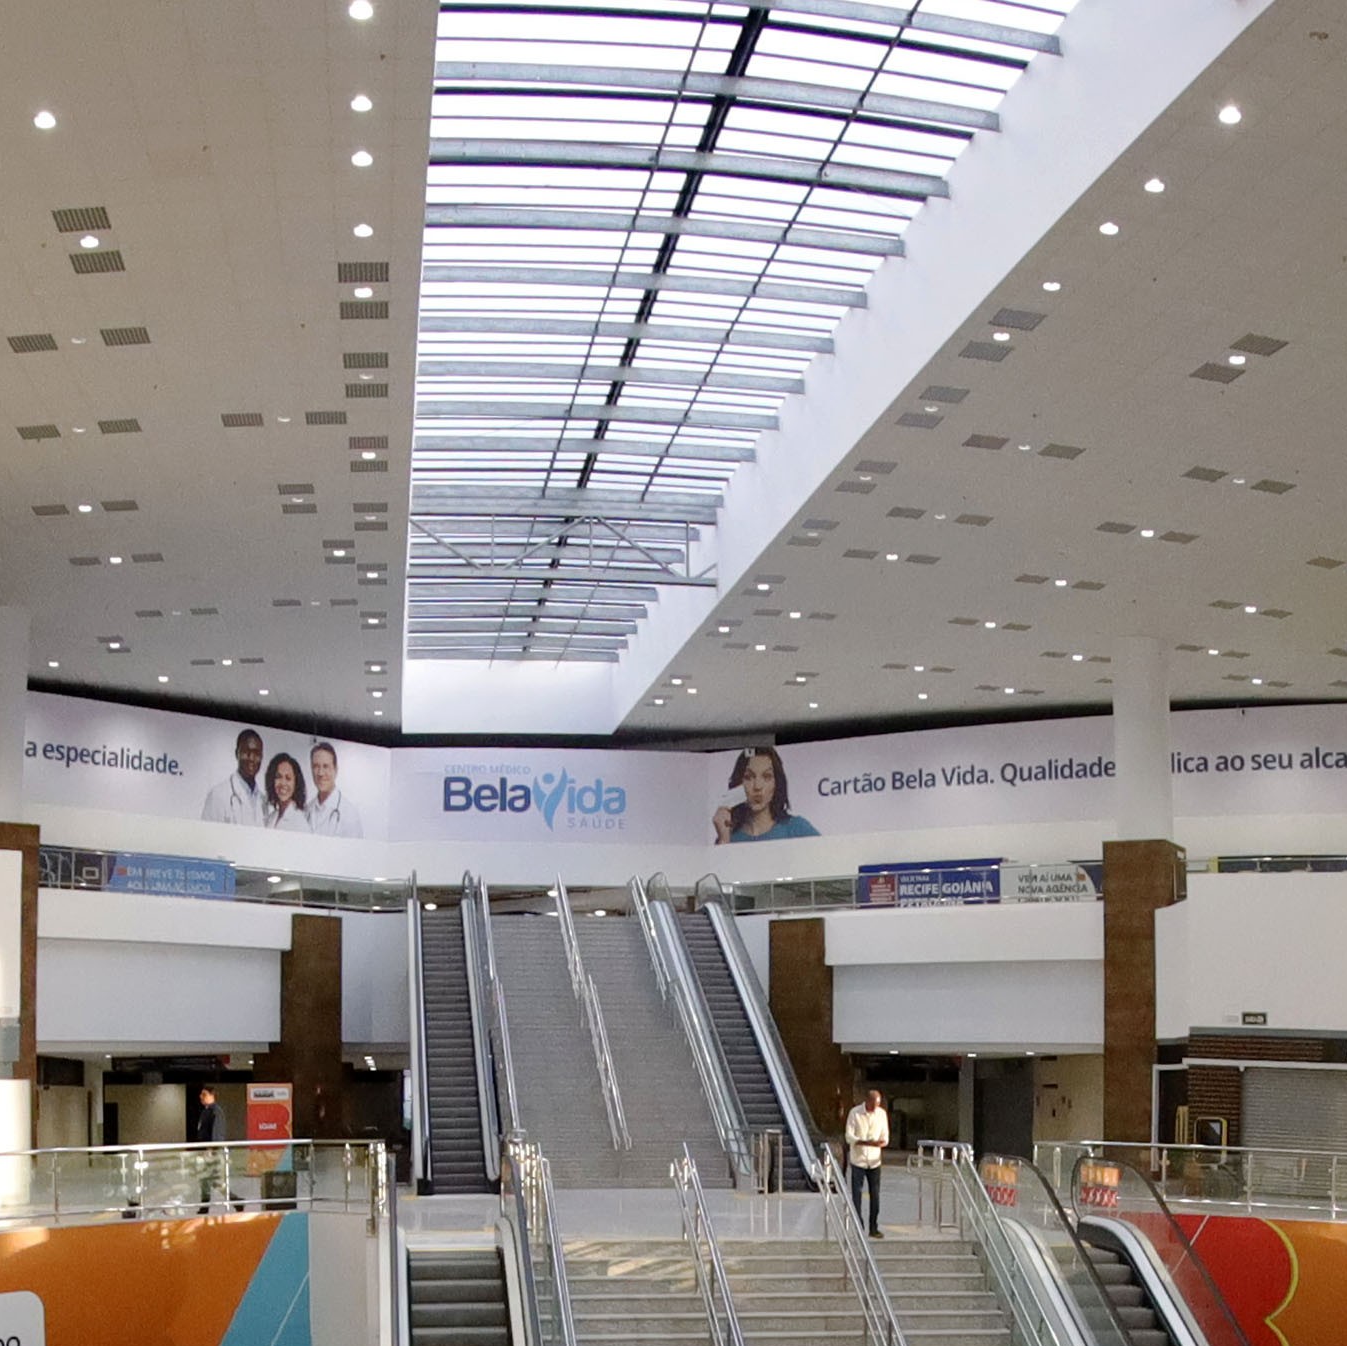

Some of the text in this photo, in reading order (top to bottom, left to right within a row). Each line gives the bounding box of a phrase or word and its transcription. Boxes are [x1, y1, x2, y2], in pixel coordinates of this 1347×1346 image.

[42, 741, 184, 777] especialidade.
[817, 772, 886, 797] Cartão
[891, 768, 936, 791] Bela
[941, 764, 995, 787] Vida.
[1000, 756, 1117, 786] Qualidade
[1215, 753, 1245, 772] ao
[1250, 751, 1293, 771] seu
[567, 814, 628, 830] SAÚDE
[1050, 873, 1073, 882] UMA
[899, 883, 939, 896] RECIFE
[1018, 885, 1043, 894] NOVA
